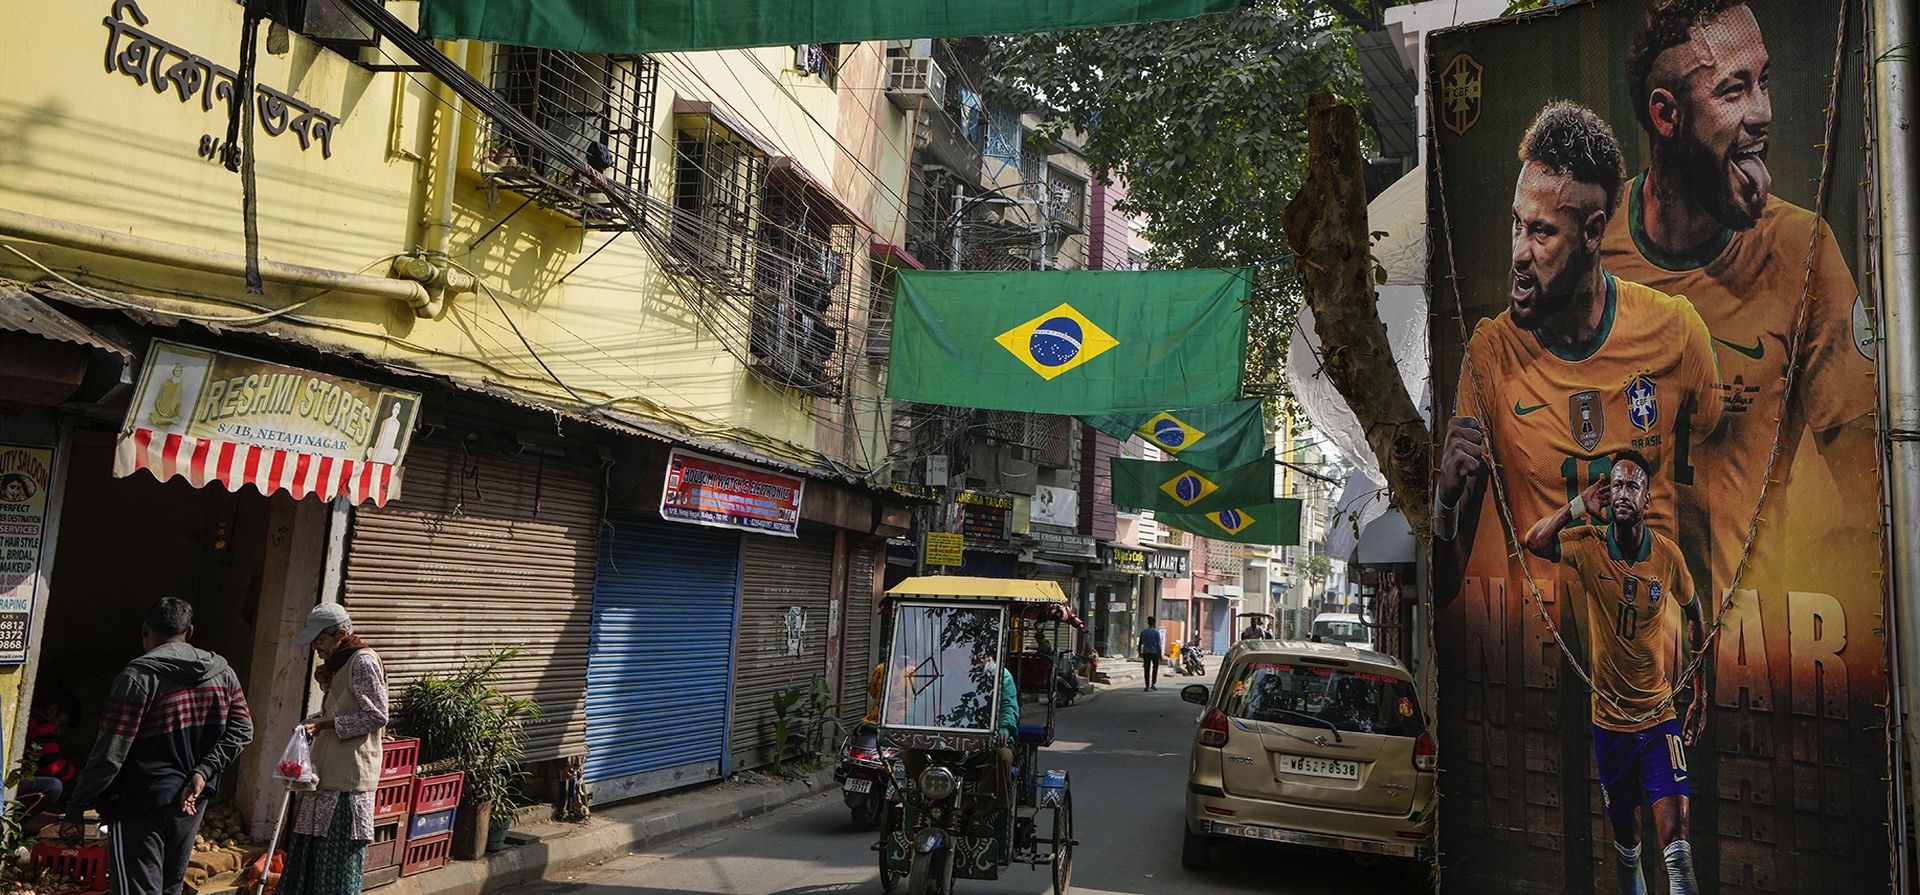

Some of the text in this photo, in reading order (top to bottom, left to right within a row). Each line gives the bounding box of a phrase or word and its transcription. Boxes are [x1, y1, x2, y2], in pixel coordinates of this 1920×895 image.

[1453, 86, 1470, 98] CBF
[255, 82, 341, 160] ভবন
[1635, 397, 1648, 407] CBF
[199, 373, 371, 446] RESHMI STORES
[257, 428, 304, 446] NETAJI
[306, 436, 348, 451] NAGAR
[1631, 434, 1662, 450] BRASIL
[17, 450, 48, 493] SALOON
[717, 473, 743, 493] WATCH
[741, 479, 750, 494] &
[749, 480, 790, 502] ELECTRONICS
[0, 504, 31, 513] PERFECT
[985, 495, 1013, 509] TAILORS
[7, 514, 41, 523] DESTINATION
[0, 525, 38, 535] SERVICES
[1041, 533, 1062, 543] KRISHNA
[1063, 535, 1083, 545] MEDICAL
[6, 549, 35, 562] BRIDAL,
[0, 561, 32, 573] MAKEUP
[6, 574, 33, 587] BRIDAL
[0, 598, 27, 610] RAPING
[0, 621, 25, 630] 6812
[1615, 601, 1638, 642] 10
[0, 630, 23, 640] 3372
[0, 640, 22, 649] 9868
[1464, 577, 1850, 720] NEAR
[1665, 733, 1687, 772] 10
